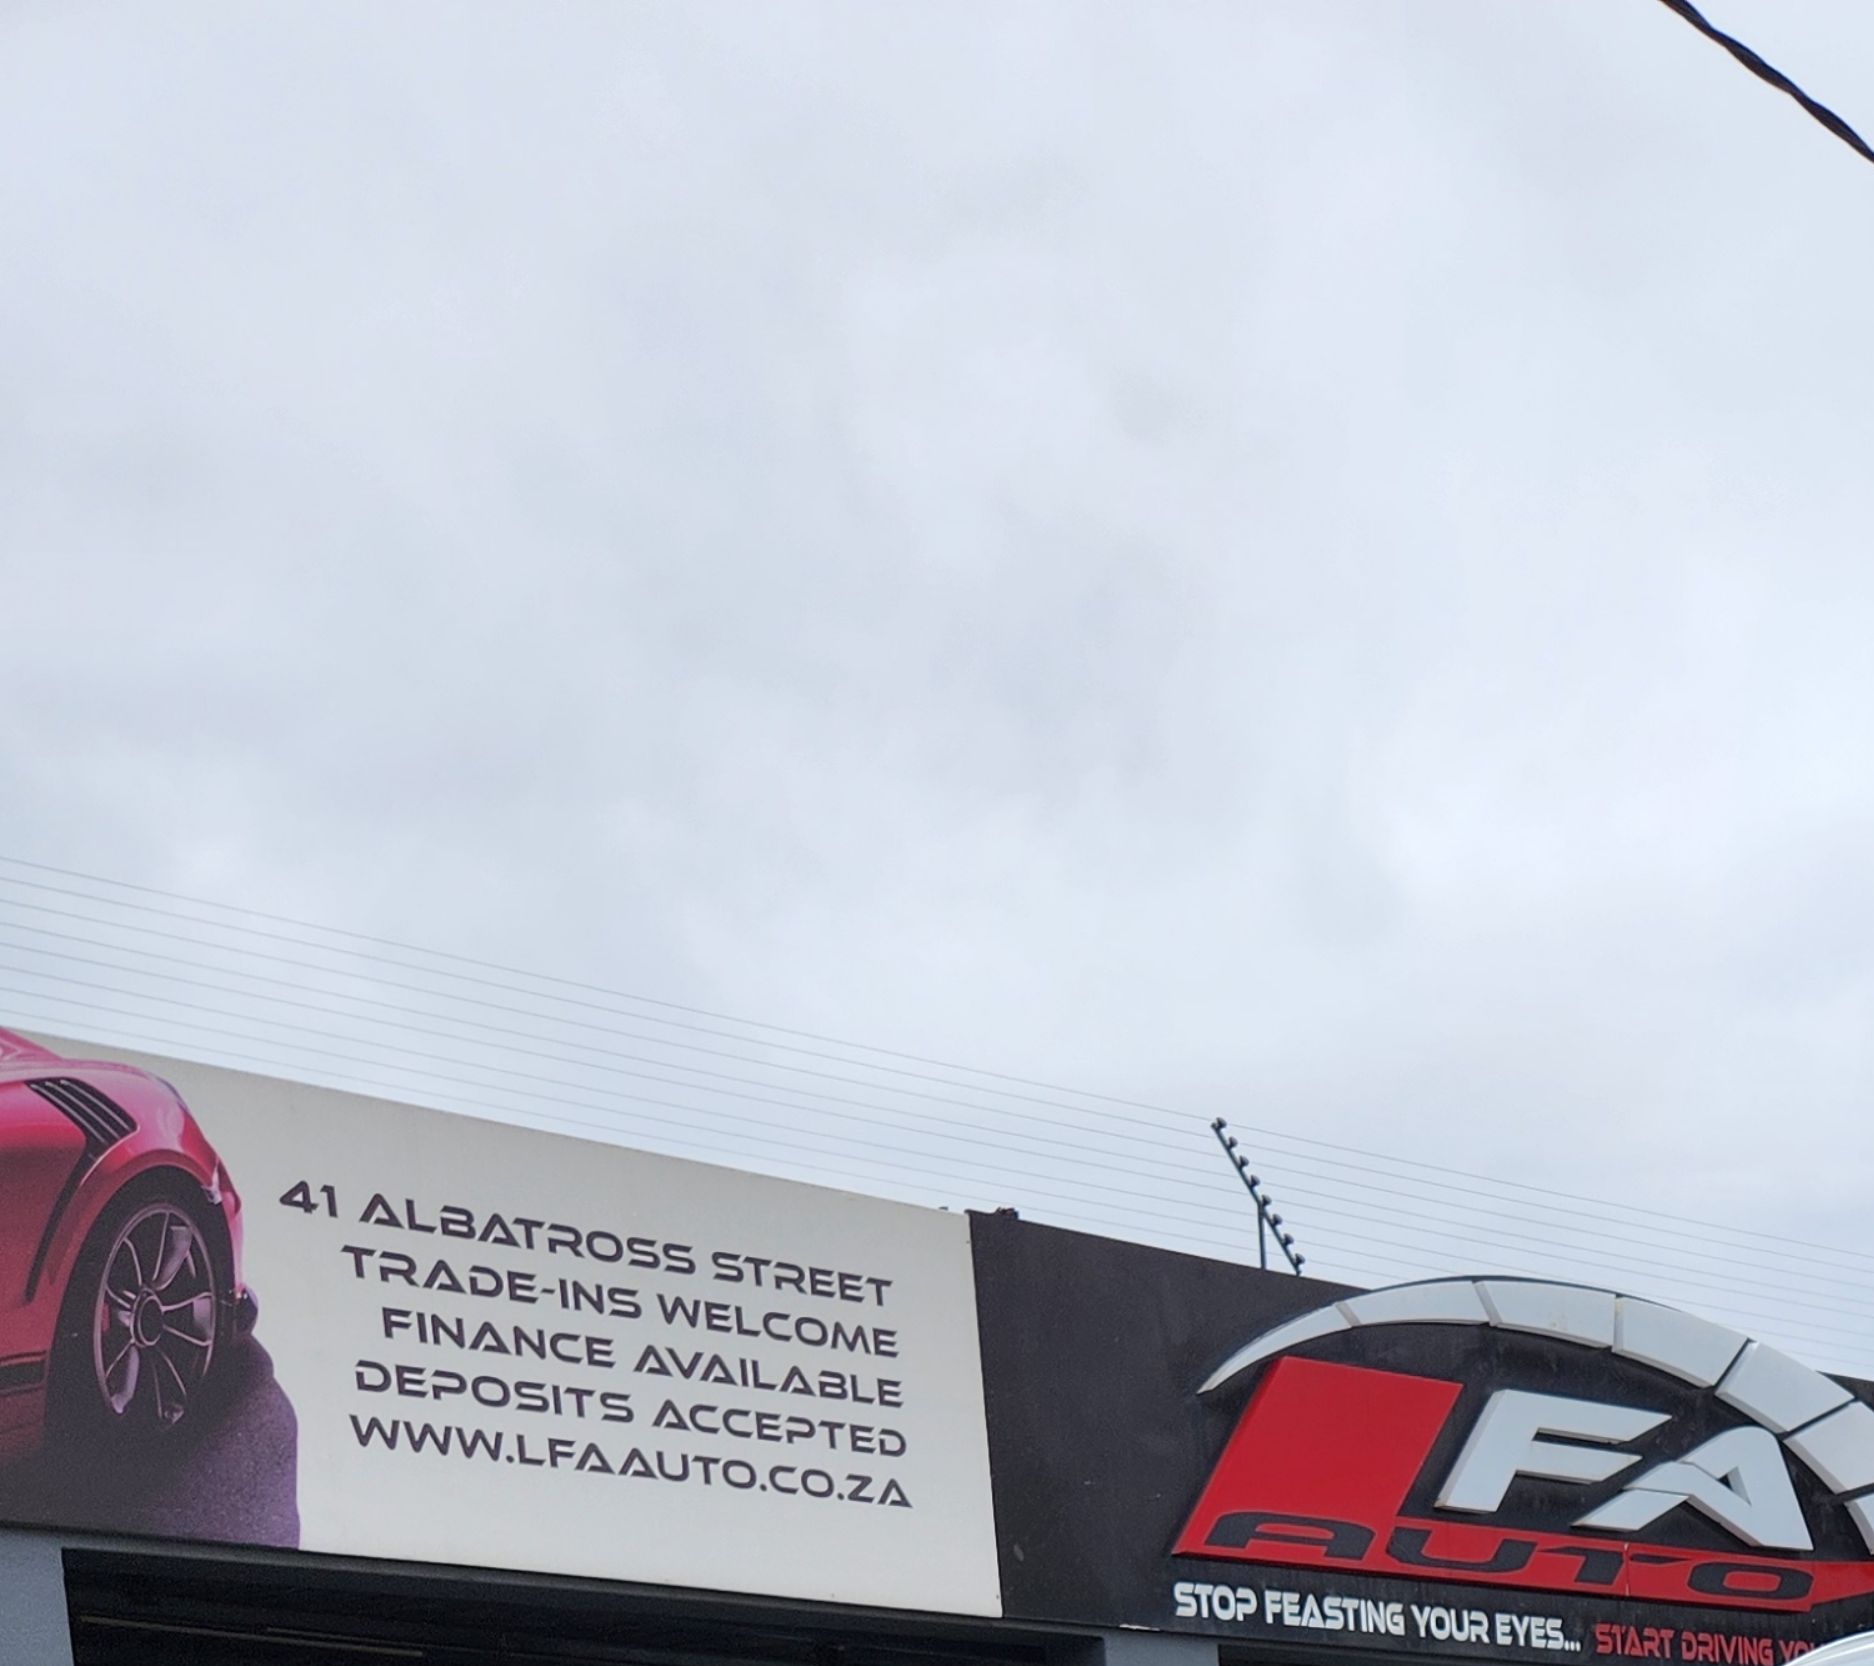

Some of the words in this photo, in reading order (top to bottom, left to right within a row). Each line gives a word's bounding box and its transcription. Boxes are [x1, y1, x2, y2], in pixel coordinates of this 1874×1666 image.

[278, 1180, 339, 1219] 41
[358, 1193, 697, 1276] ALBATROSS
[711, 1251, 894, 1307] STREET
[341, 1245, 643, 1320] TRADE-INS
[656, 1293, 900, 1358] WELCOME
[382, 1307, 617, 1369] FINANCE
[633, 1345, 904, 1409] AVAILABLE
[354, 1360, 635, 1425] DEPOSITS
[651, 1399, 908, 1458] ACCEPTED
[348, 1414, 914, 1509] WWW.LFAAUTO.CO.ZA
[1202, 1509, 1815, 1602] AUTO
[1173, 1581, 1258, 1622] STOP
[1264, 1589, 1405, 1637] FEASTING
[1411, 1604, 1490, 1645] YOUR
[1495, 1613, 1582, 1653] EYES...
[1595, 1622, 1676, 1661] START
